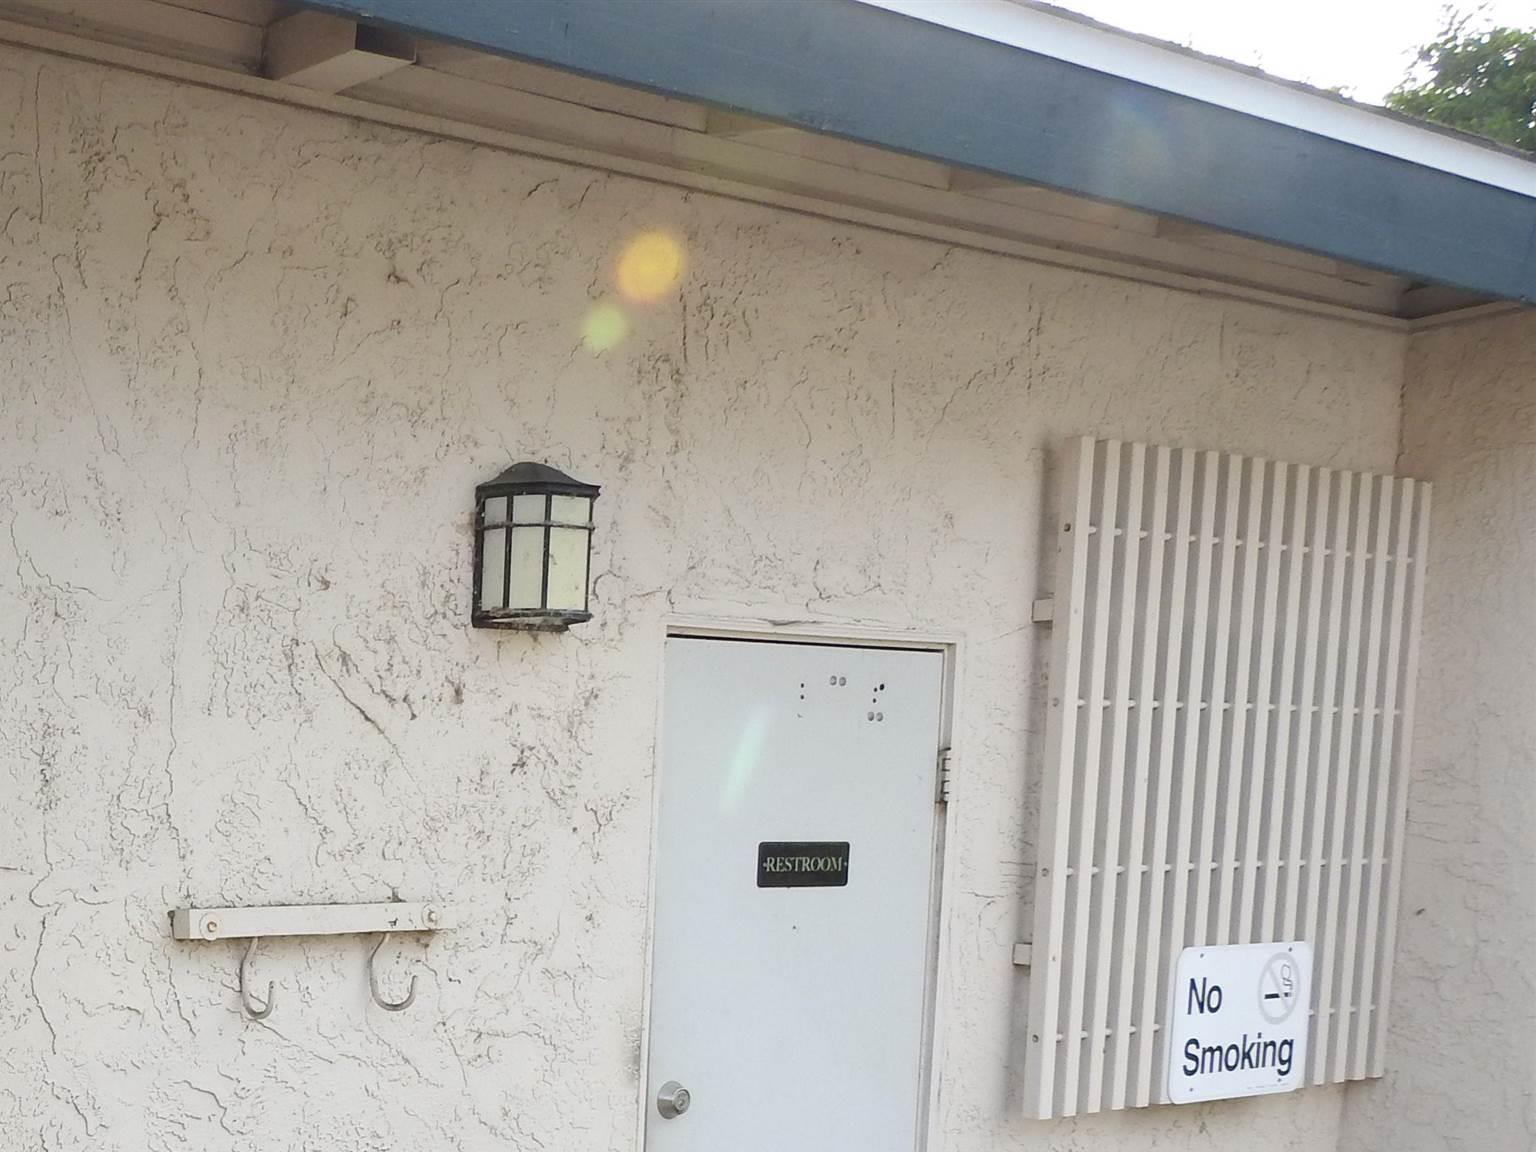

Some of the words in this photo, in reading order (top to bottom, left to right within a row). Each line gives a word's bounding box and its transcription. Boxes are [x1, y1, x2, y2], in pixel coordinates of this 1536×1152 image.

[766, 856, 843, 872] RESTROOM
[1187, 977, 1223, 1015] No
[1182, 1032, 1295, 1077] Smoking
